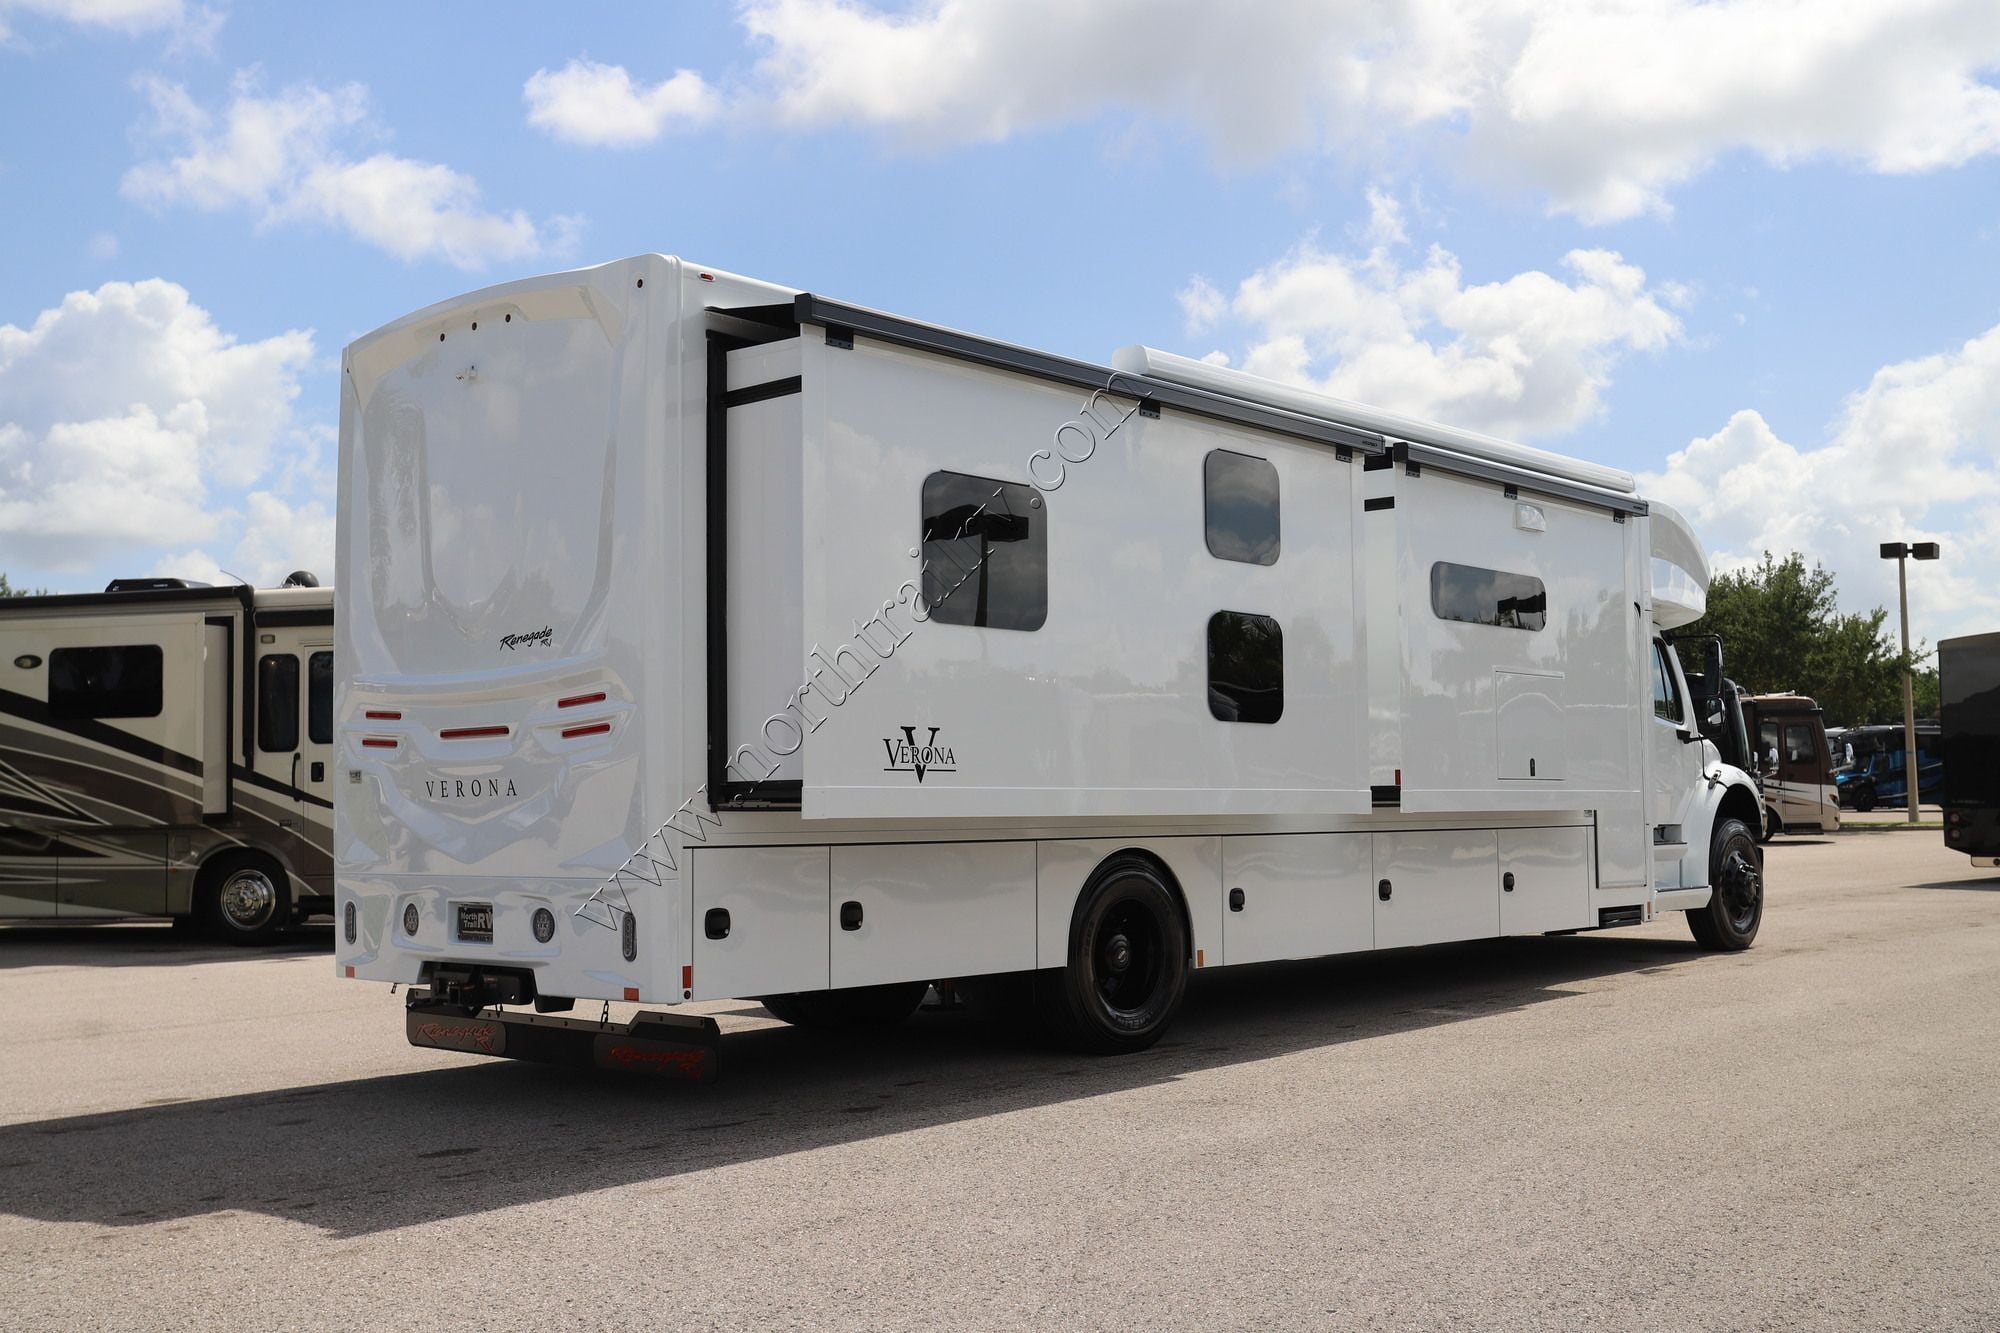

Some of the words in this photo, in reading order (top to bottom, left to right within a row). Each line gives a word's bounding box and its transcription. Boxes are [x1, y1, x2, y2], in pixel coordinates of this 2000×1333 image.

[499, 624, 553, 651] Renegade
[540, 638, 553, 647] RV
[882, 738, 956, 768] VERONA
[425, 778, 518, 798] VERONA
[460, 911, 478, 921] North
[463, 919, 478, 929] Trail
[477, 911, 493, 929] RV
[415, 1022, 496, 1045] Renegade
